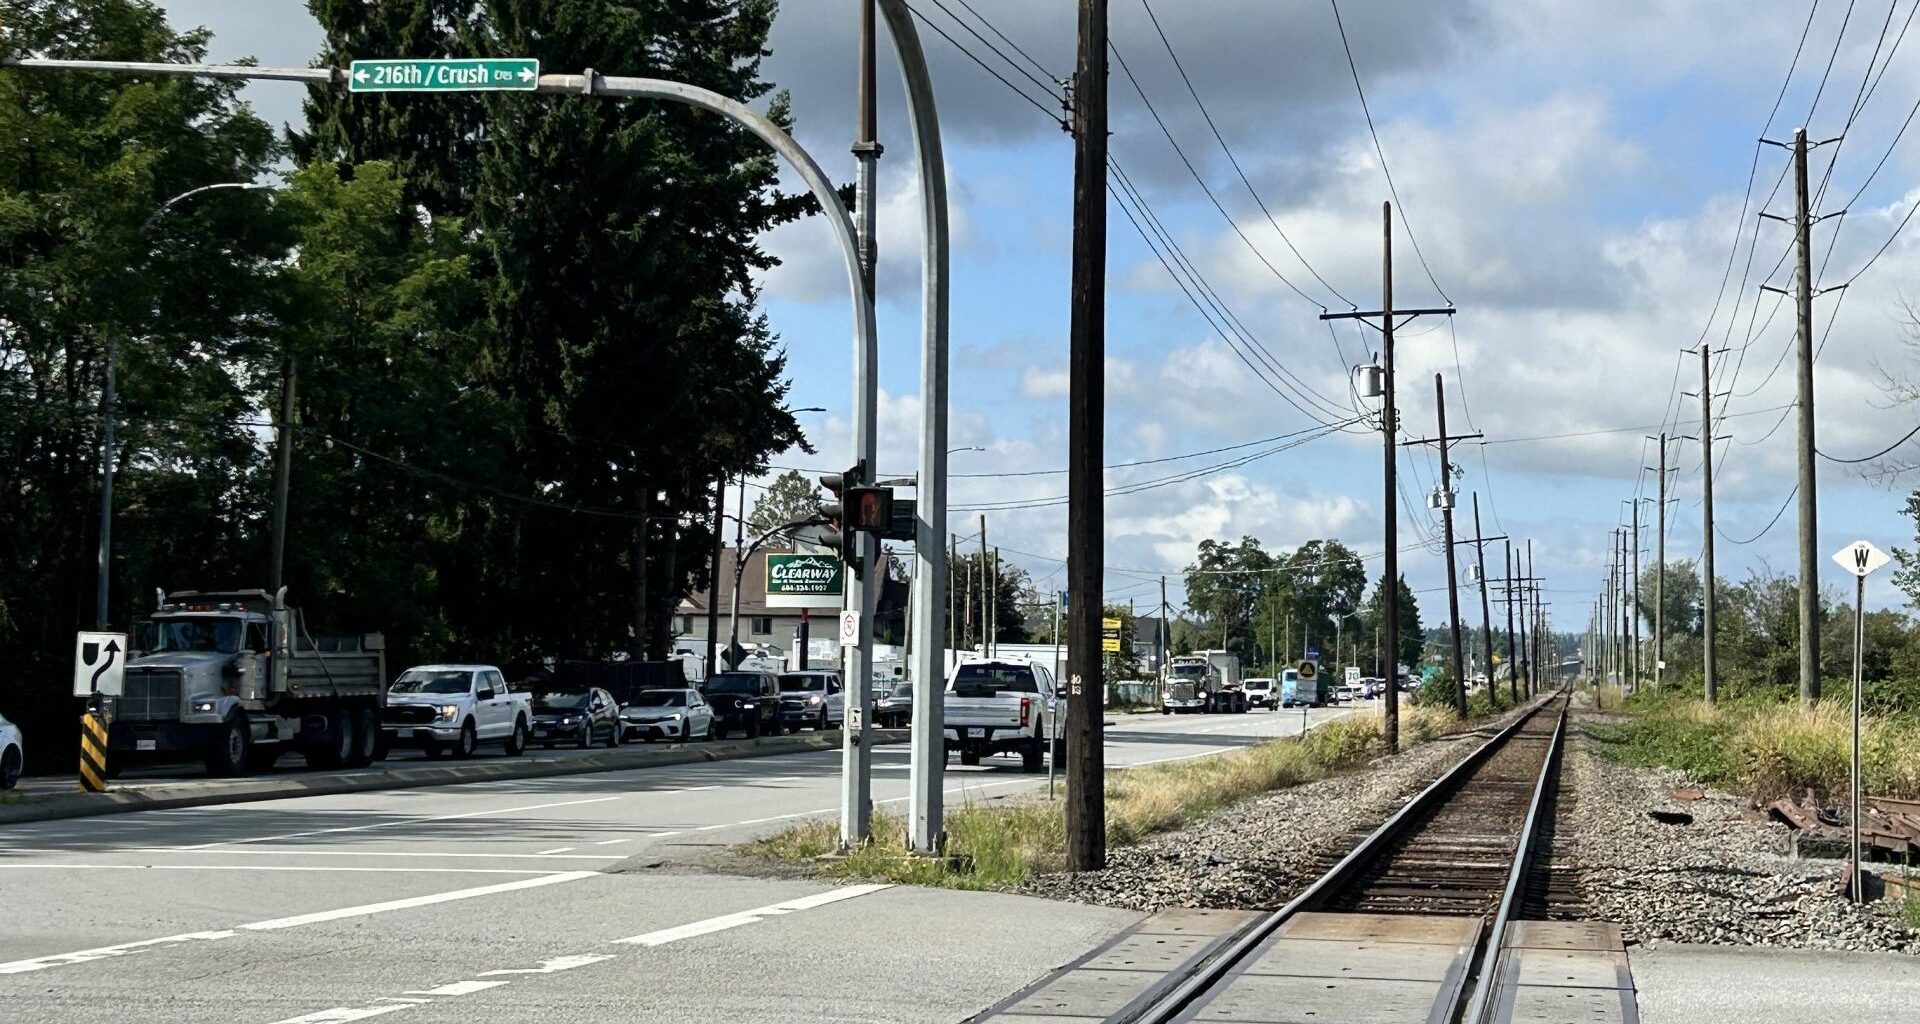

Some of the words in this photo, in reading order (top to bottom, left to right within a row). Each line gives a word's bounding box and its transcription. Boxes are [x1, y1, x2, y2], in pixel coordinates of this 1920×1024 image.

[373, 66, 422, 85] 216th
[437, 64, 489, 84] Crush
[1854, 548, 1870, 568] W
[1347, 671, 1359, 681] 70
